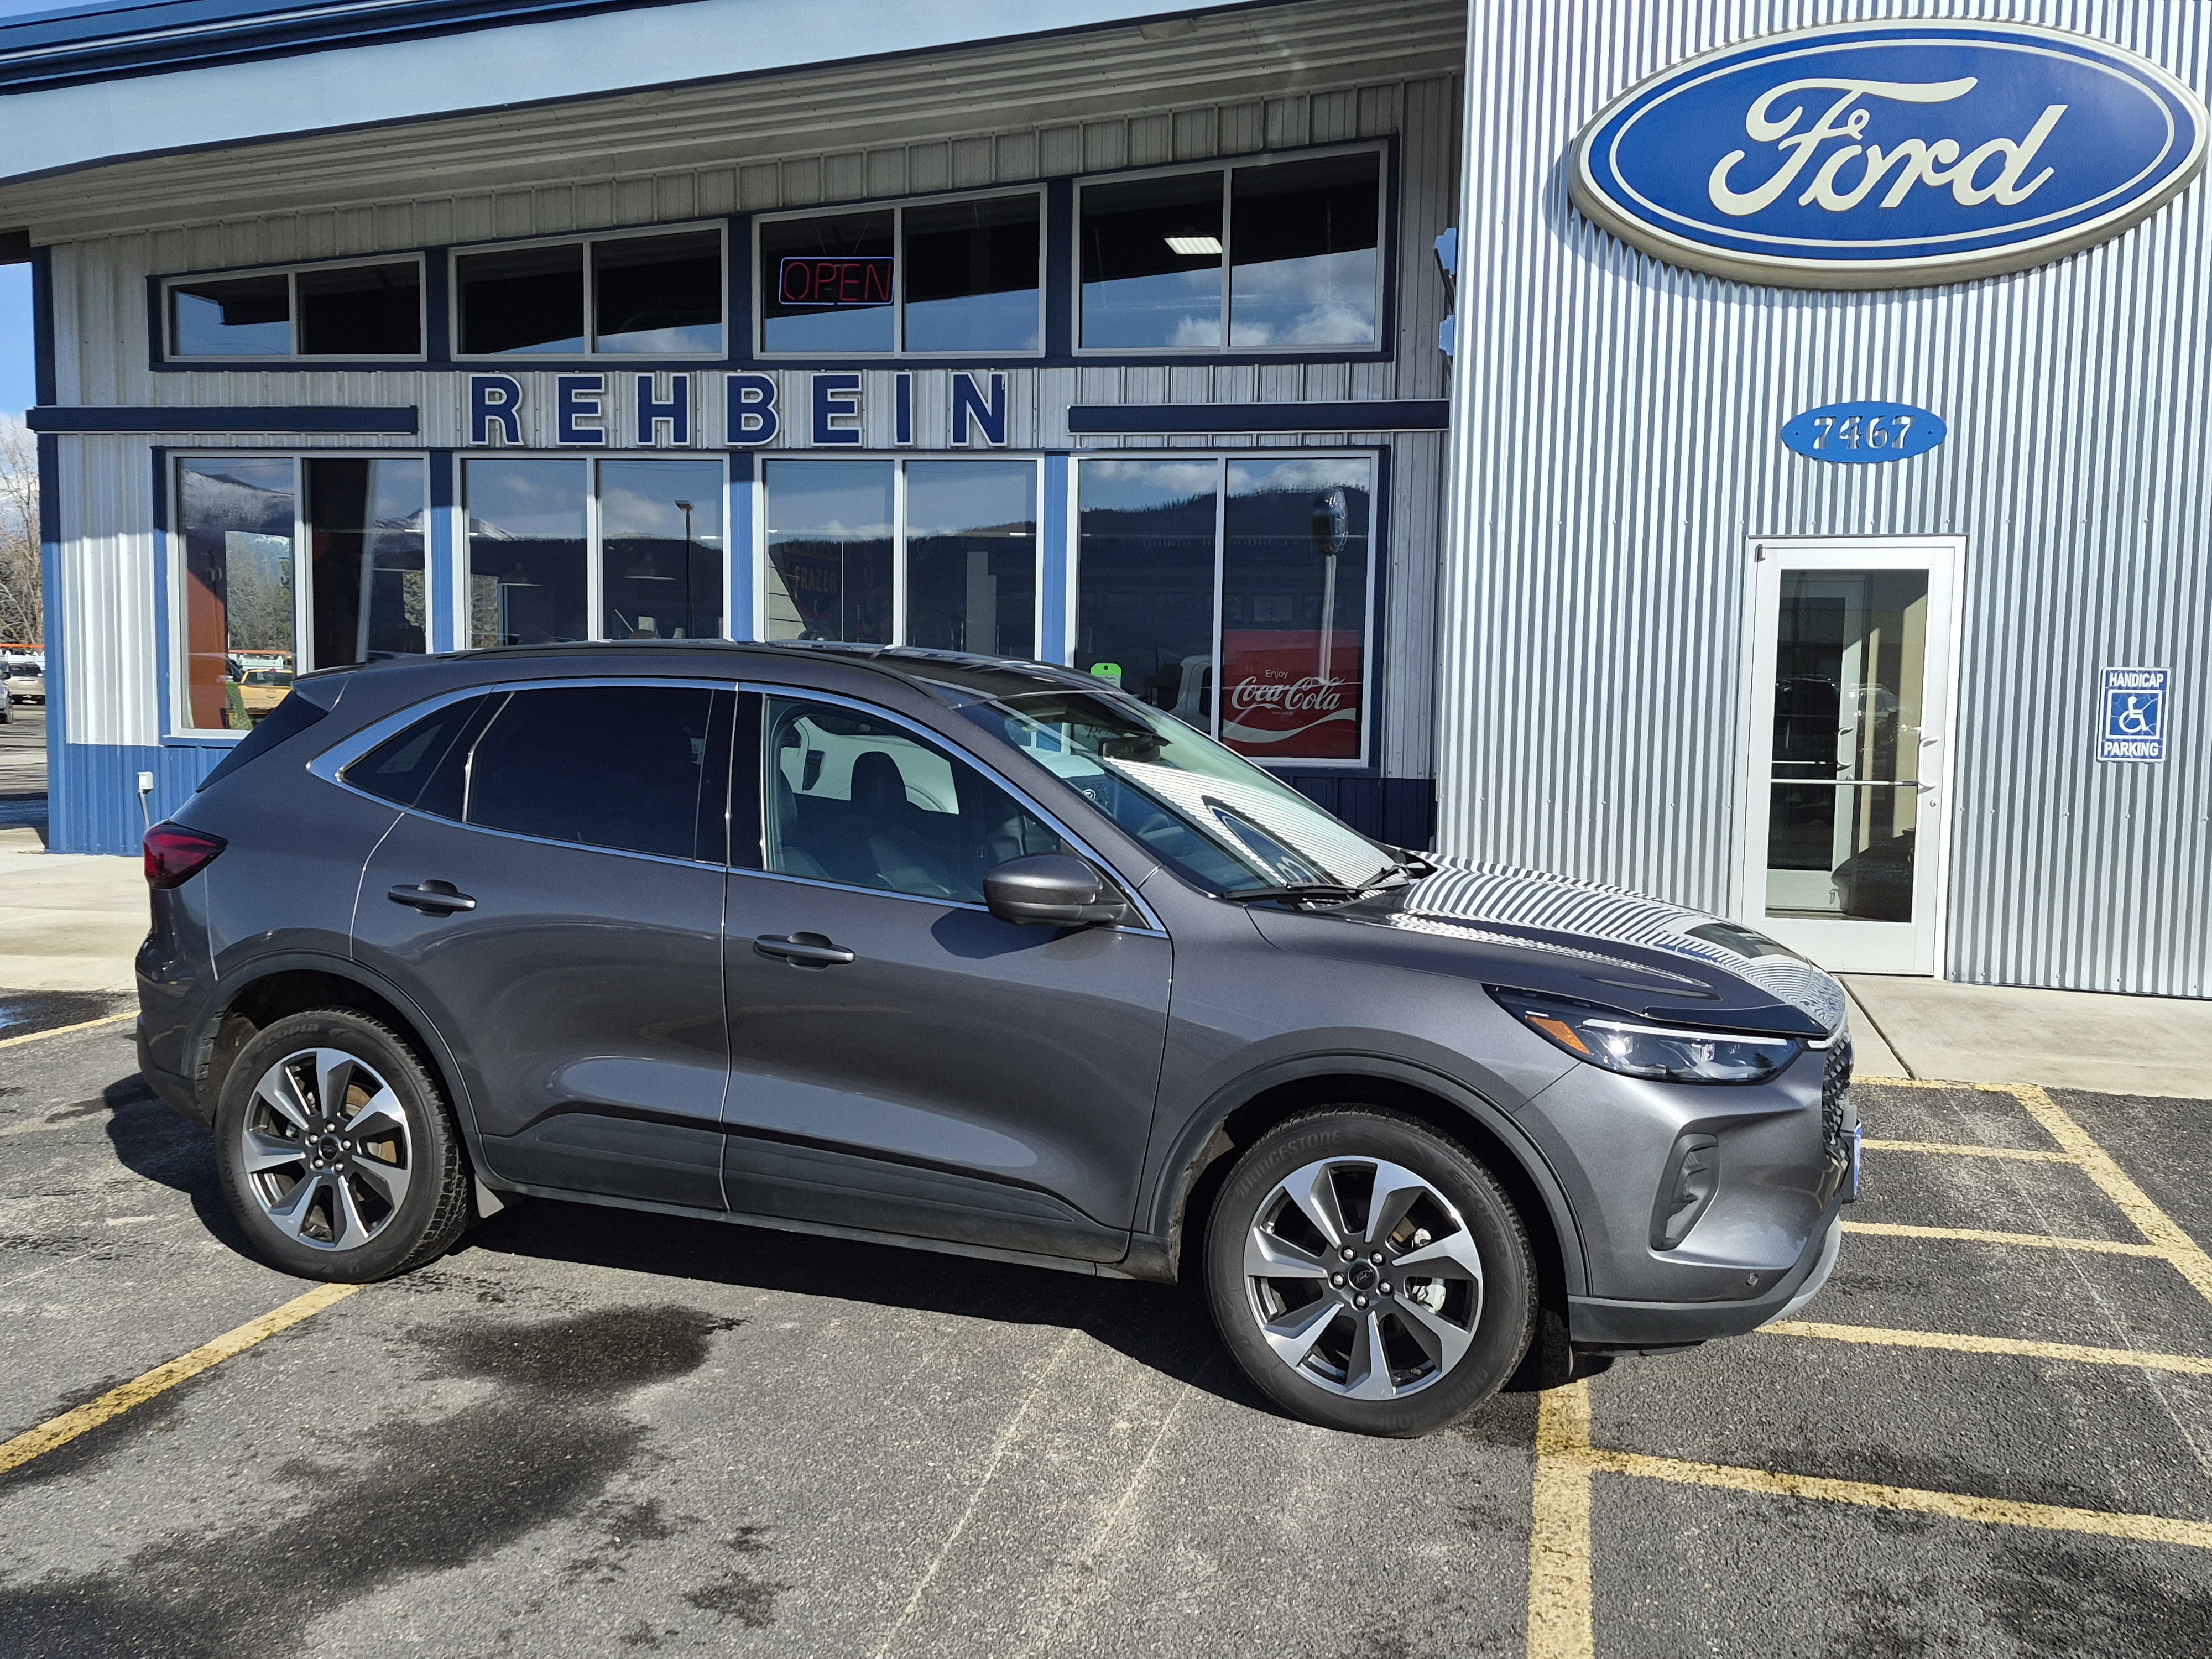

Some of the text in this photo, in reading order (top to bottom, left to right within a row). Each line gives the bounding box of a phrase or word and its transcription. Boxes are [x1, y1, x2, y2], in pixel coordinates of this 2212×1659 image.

[1708, 77, 2069, 216] Ford
[784, 262, 892, 301] OPEN
[467, 371, 1009, 448] REHBEIN
[1813, 416, 1917, 450] 7467
[794, 565, 838, 594] FRAZER
[1265, 669, 1288, 679] Enjoy
[2109, 672, 2164, 687] HANDICAP
[2104, 741, 2159, 757] PARKING
